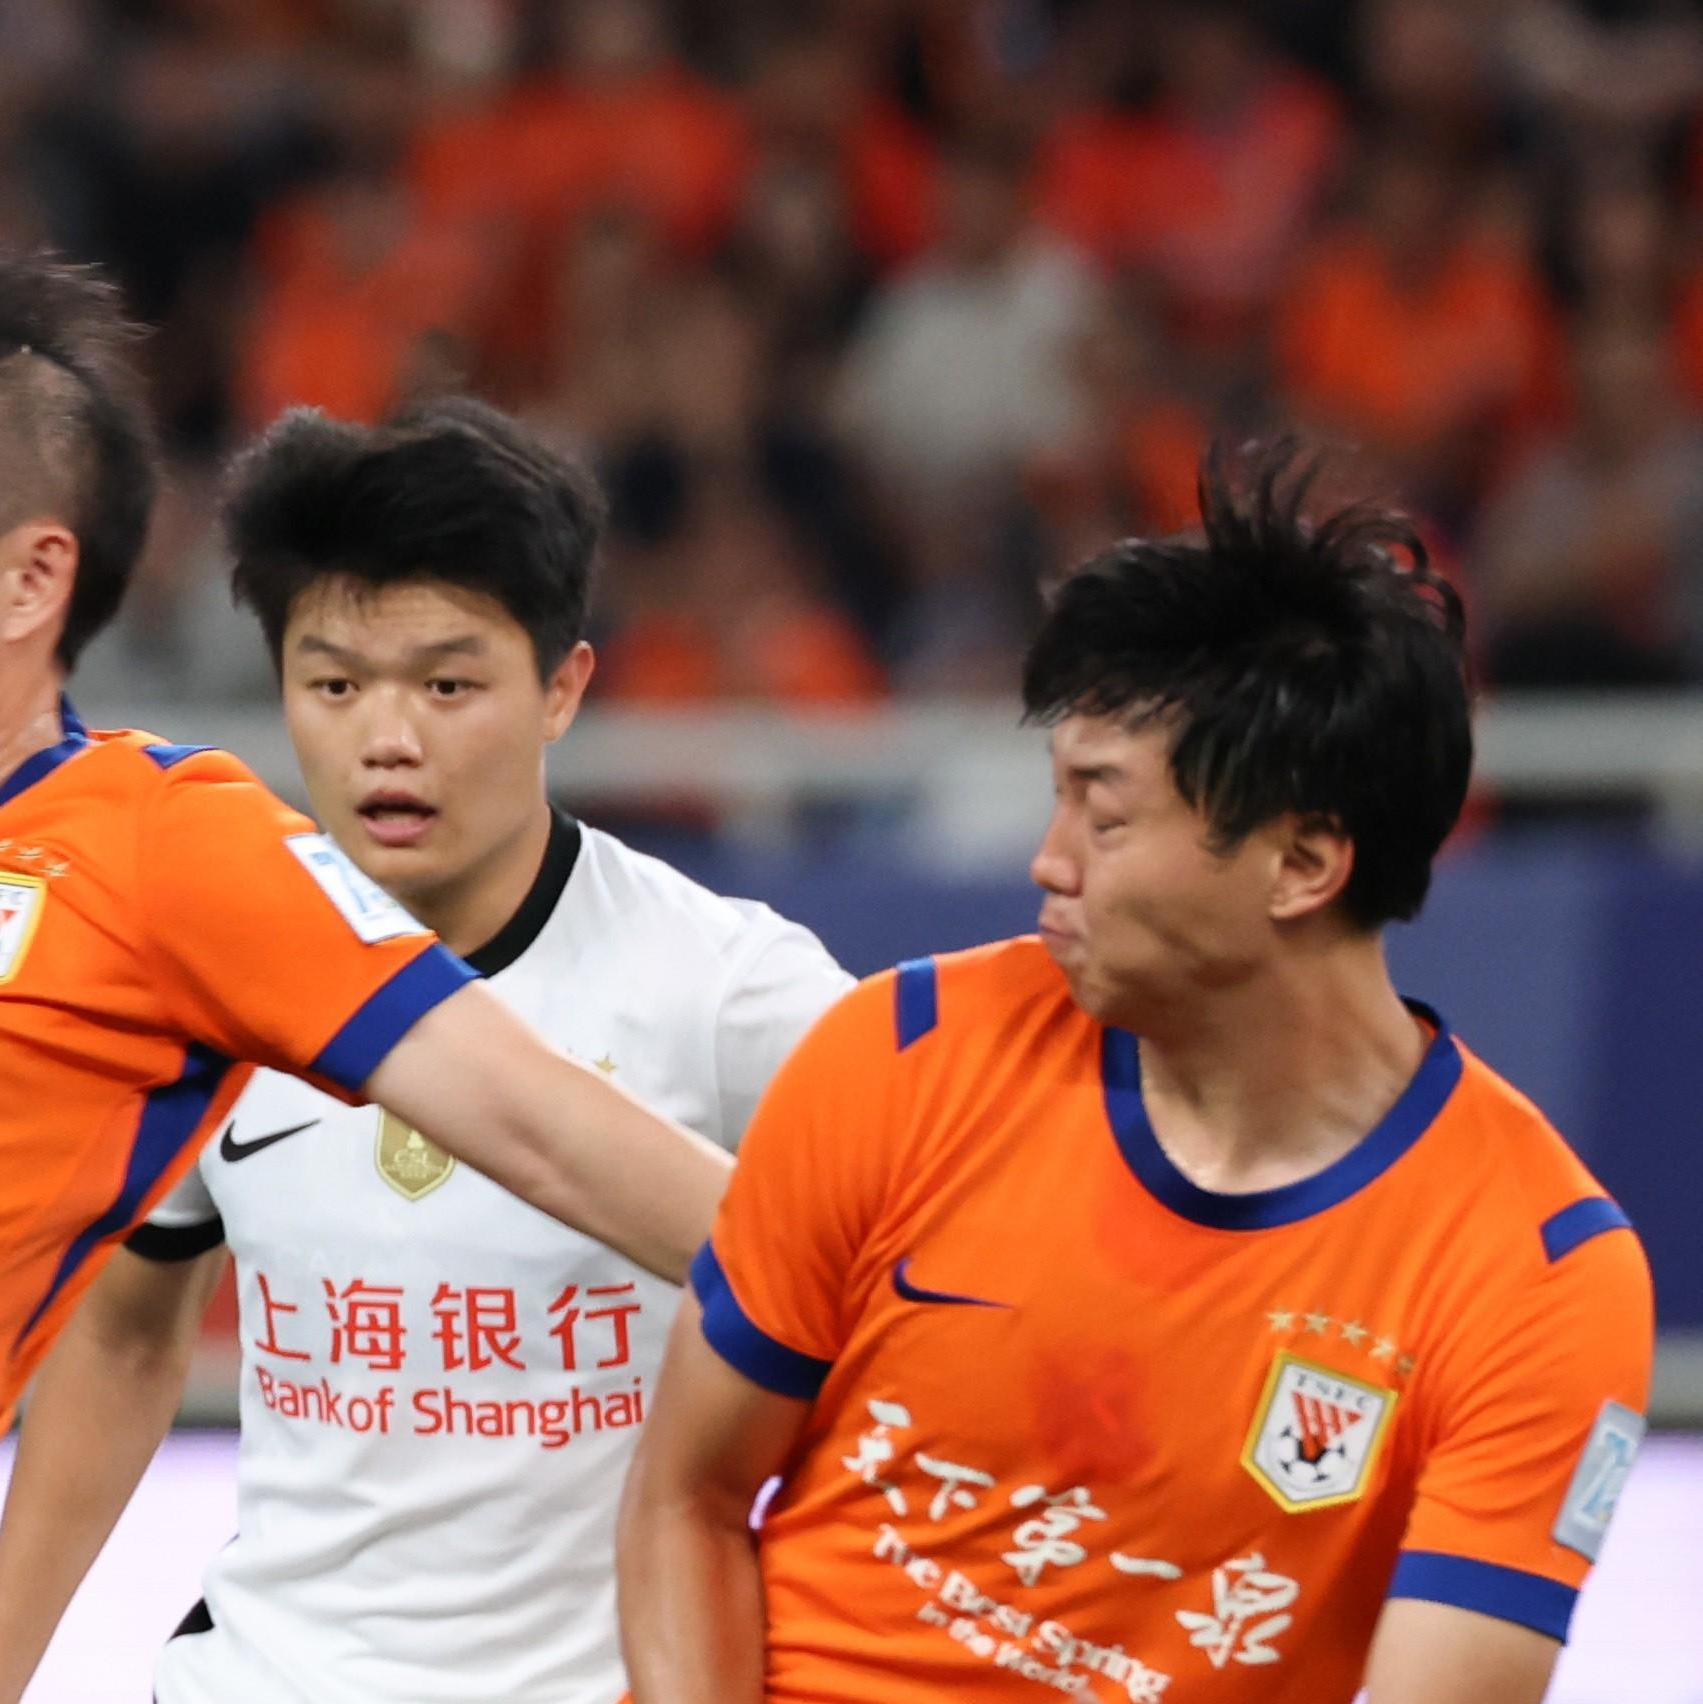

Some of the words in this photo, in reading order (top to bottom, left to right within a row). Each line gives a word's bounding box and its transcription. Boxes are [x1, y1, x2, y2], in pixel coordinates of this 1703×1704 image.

[254, 1271, 642, 1372] 上海银行
[256, 1366, 346, 1429] Bank
[347, 1385, 396, 1434] of
[412, 1376, 643, 1449] Shanghai
